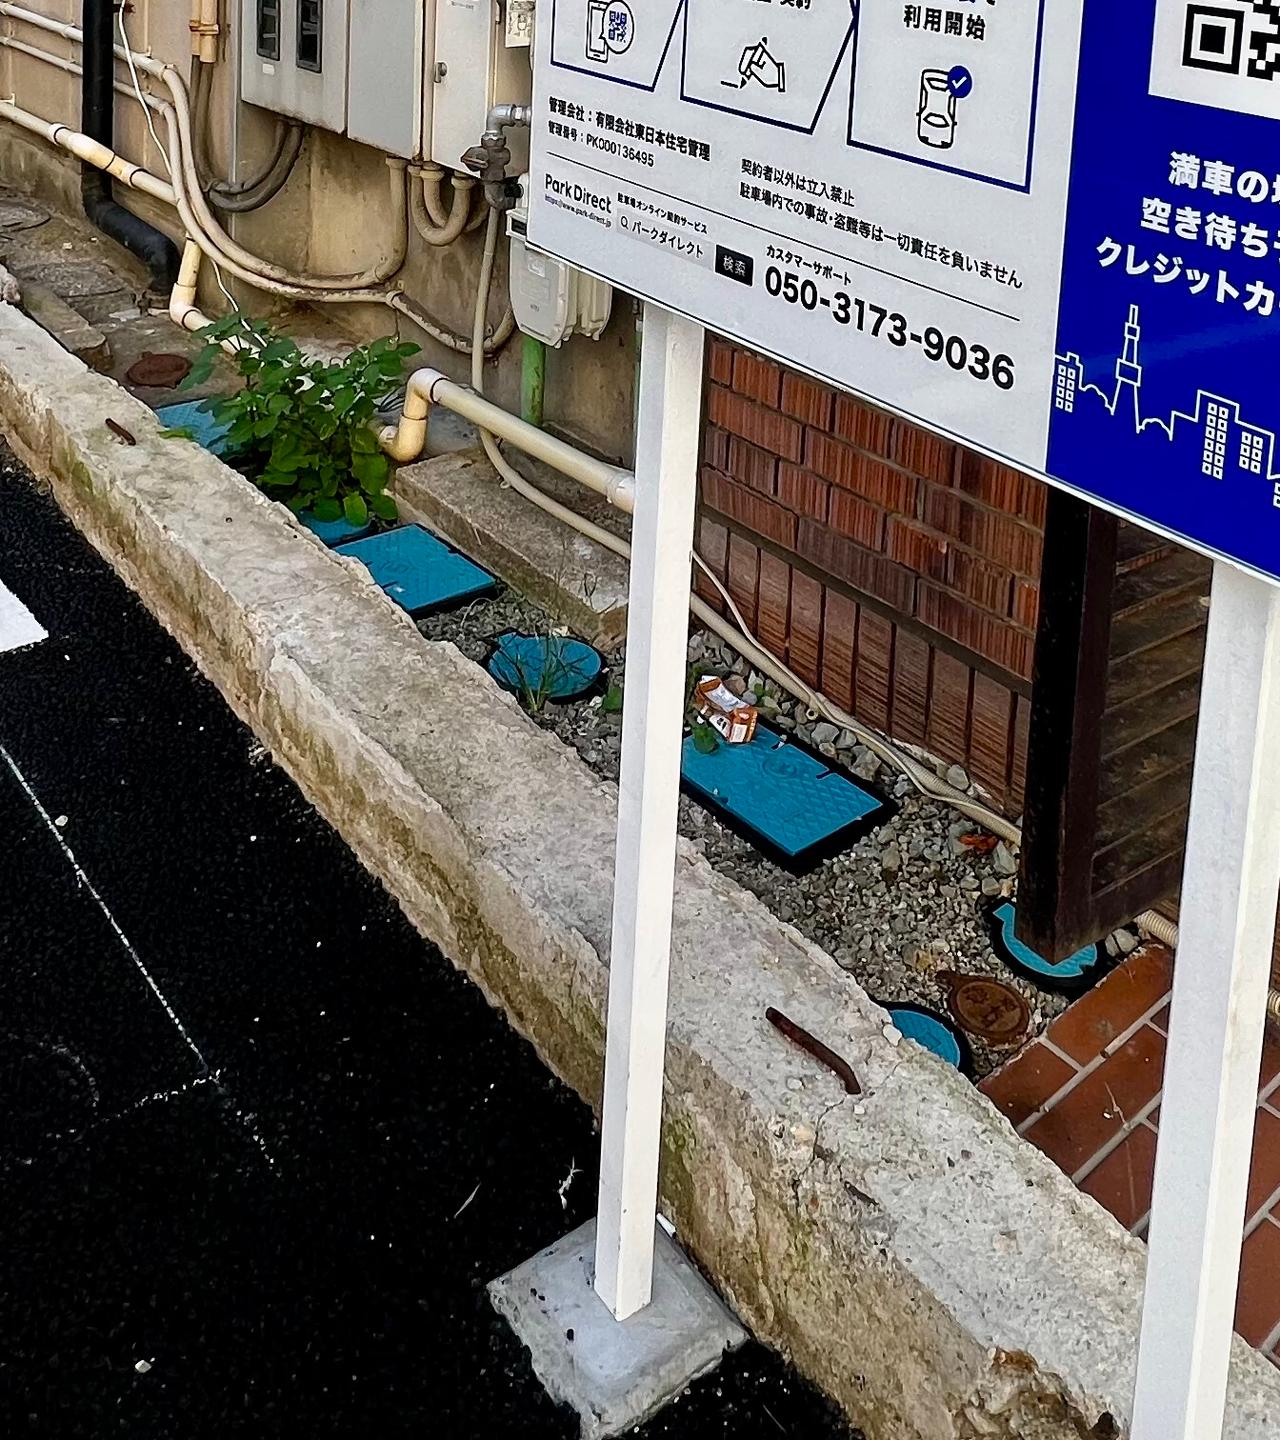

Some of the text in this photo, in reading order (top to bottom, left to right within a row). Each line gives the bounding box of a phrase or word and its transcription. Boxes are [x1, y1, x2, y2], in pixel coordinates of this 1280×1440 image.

[902, 4, 987, 41] 利用開始
[545, 173, 613, 213] Park Direct
[740, 158, 856, 208] 契約者以外は立入禁止
[631, 220, 704, 259] パークダイレクト
[739, 182, 1024, 290] 駐車場内での事故・盗難等は一切責任を負いません
[722, 254, 747, 278] 検索
[765, 244, 853, 286] カスタマーサポート
[764, 265, 1017, 391] 050-3173-9036
